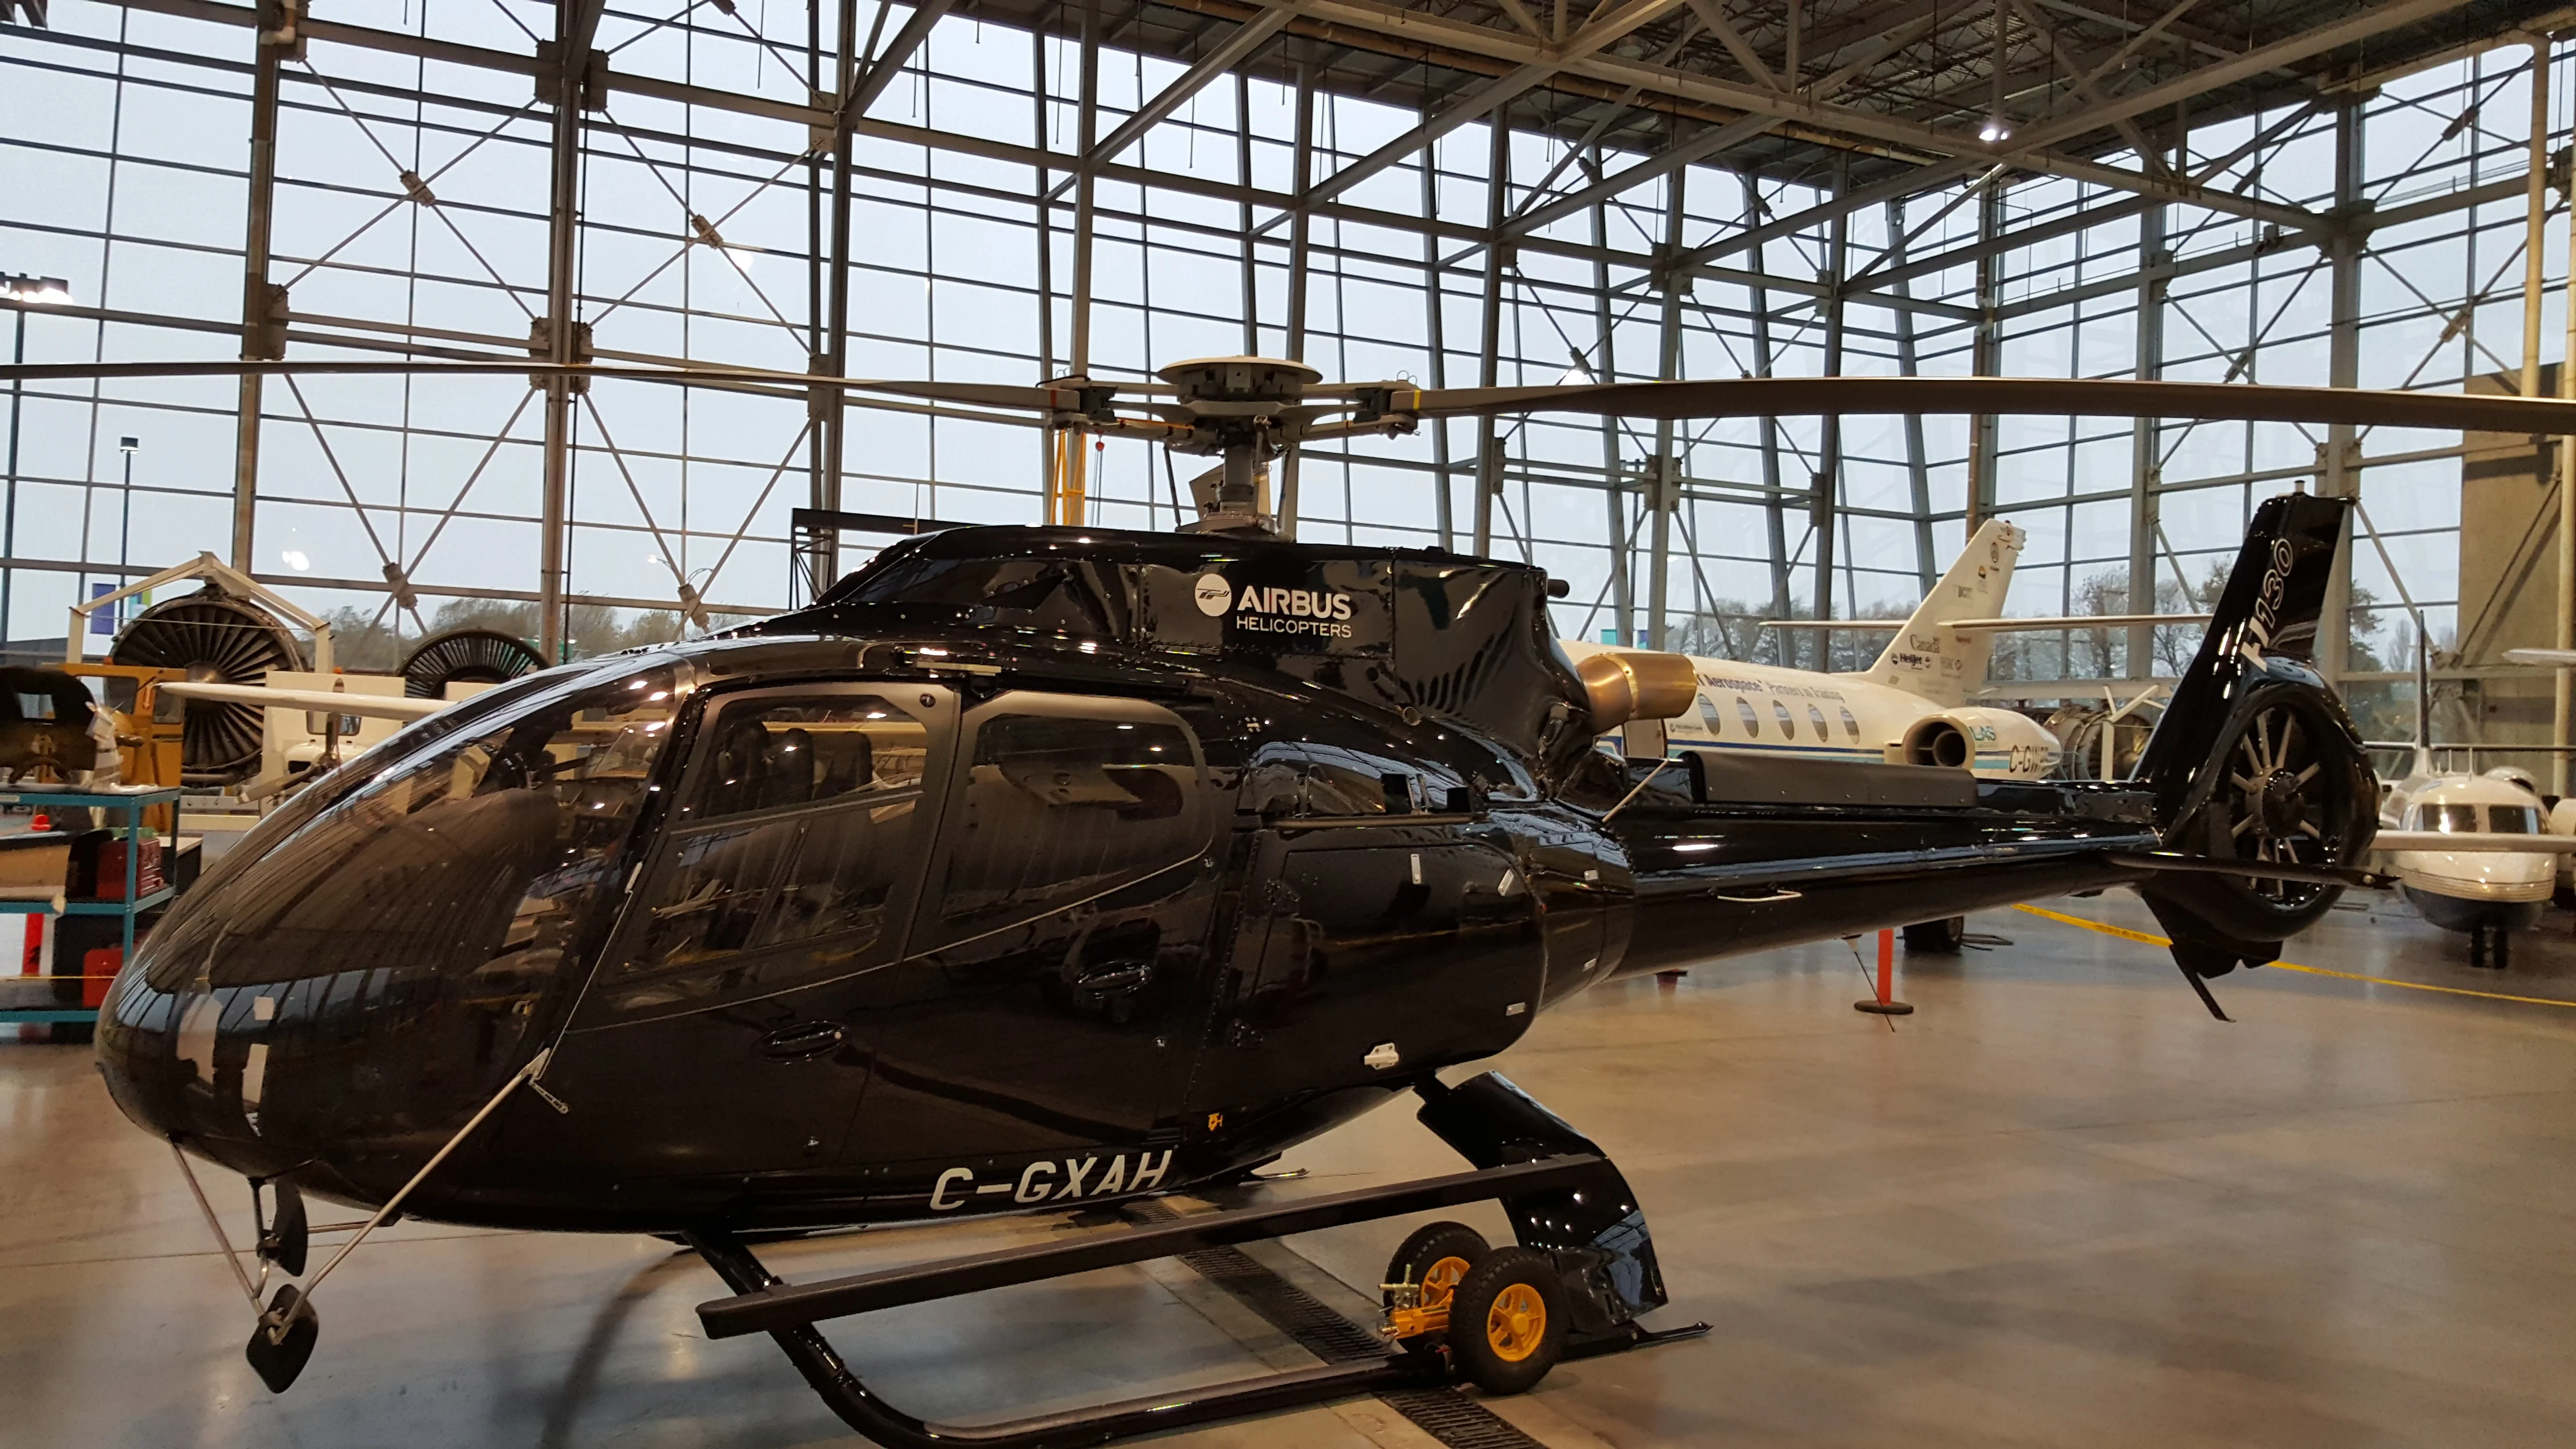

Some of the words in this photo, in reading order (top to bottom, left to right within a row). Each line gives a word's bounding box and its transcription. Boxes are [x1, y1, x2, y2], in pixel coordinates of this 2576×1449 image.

[1237, 585, 1351, 620] AIRBUS
[1237, 616, 1352, 638] HELICOPTERS
[1969, 725, 1996, 741] LAS
[930, 1150, 1173, 1210] C-GXAH
